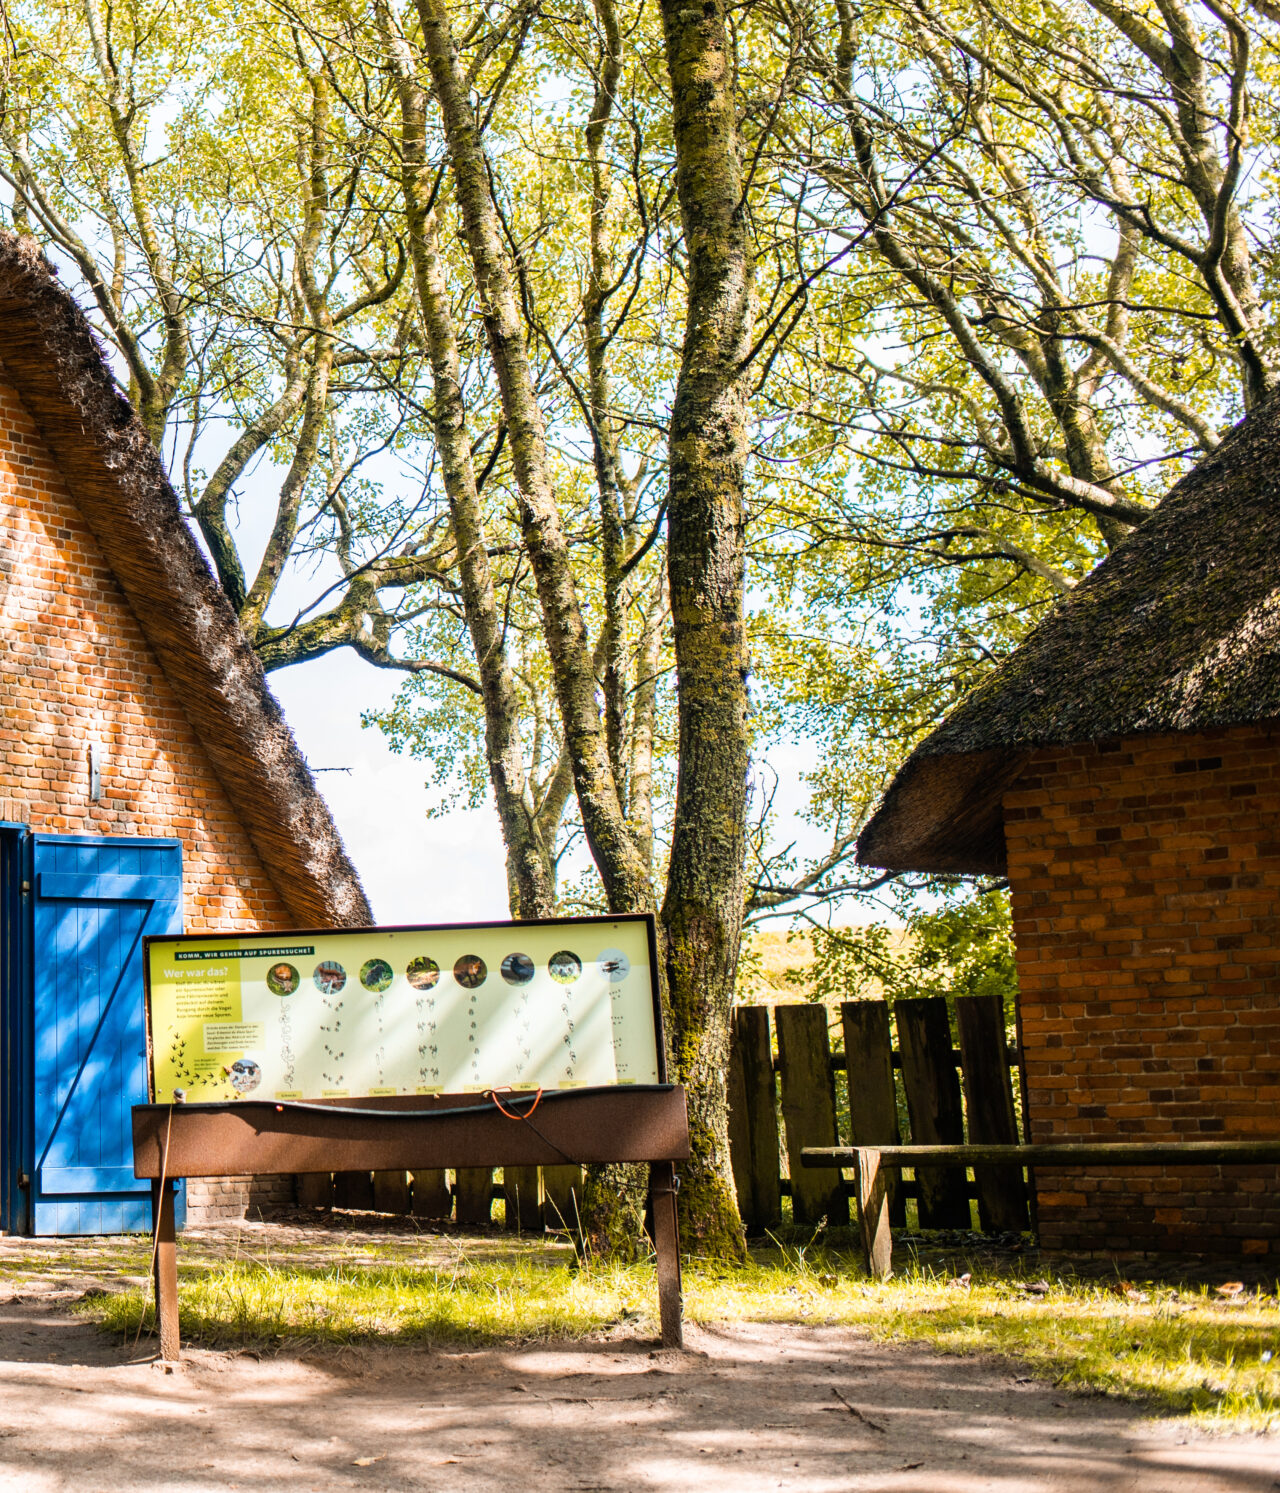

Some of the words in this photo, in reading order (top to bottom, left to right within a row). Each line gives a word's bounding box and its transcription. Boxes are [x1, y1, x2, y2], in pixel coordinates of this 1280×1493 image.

[259, 947, 311, 956] SPURENSUCHE!
[163, 968, 184, 978] Wer
[186, 968, 205, 977] war
[206, 966, 229, 976] das?
